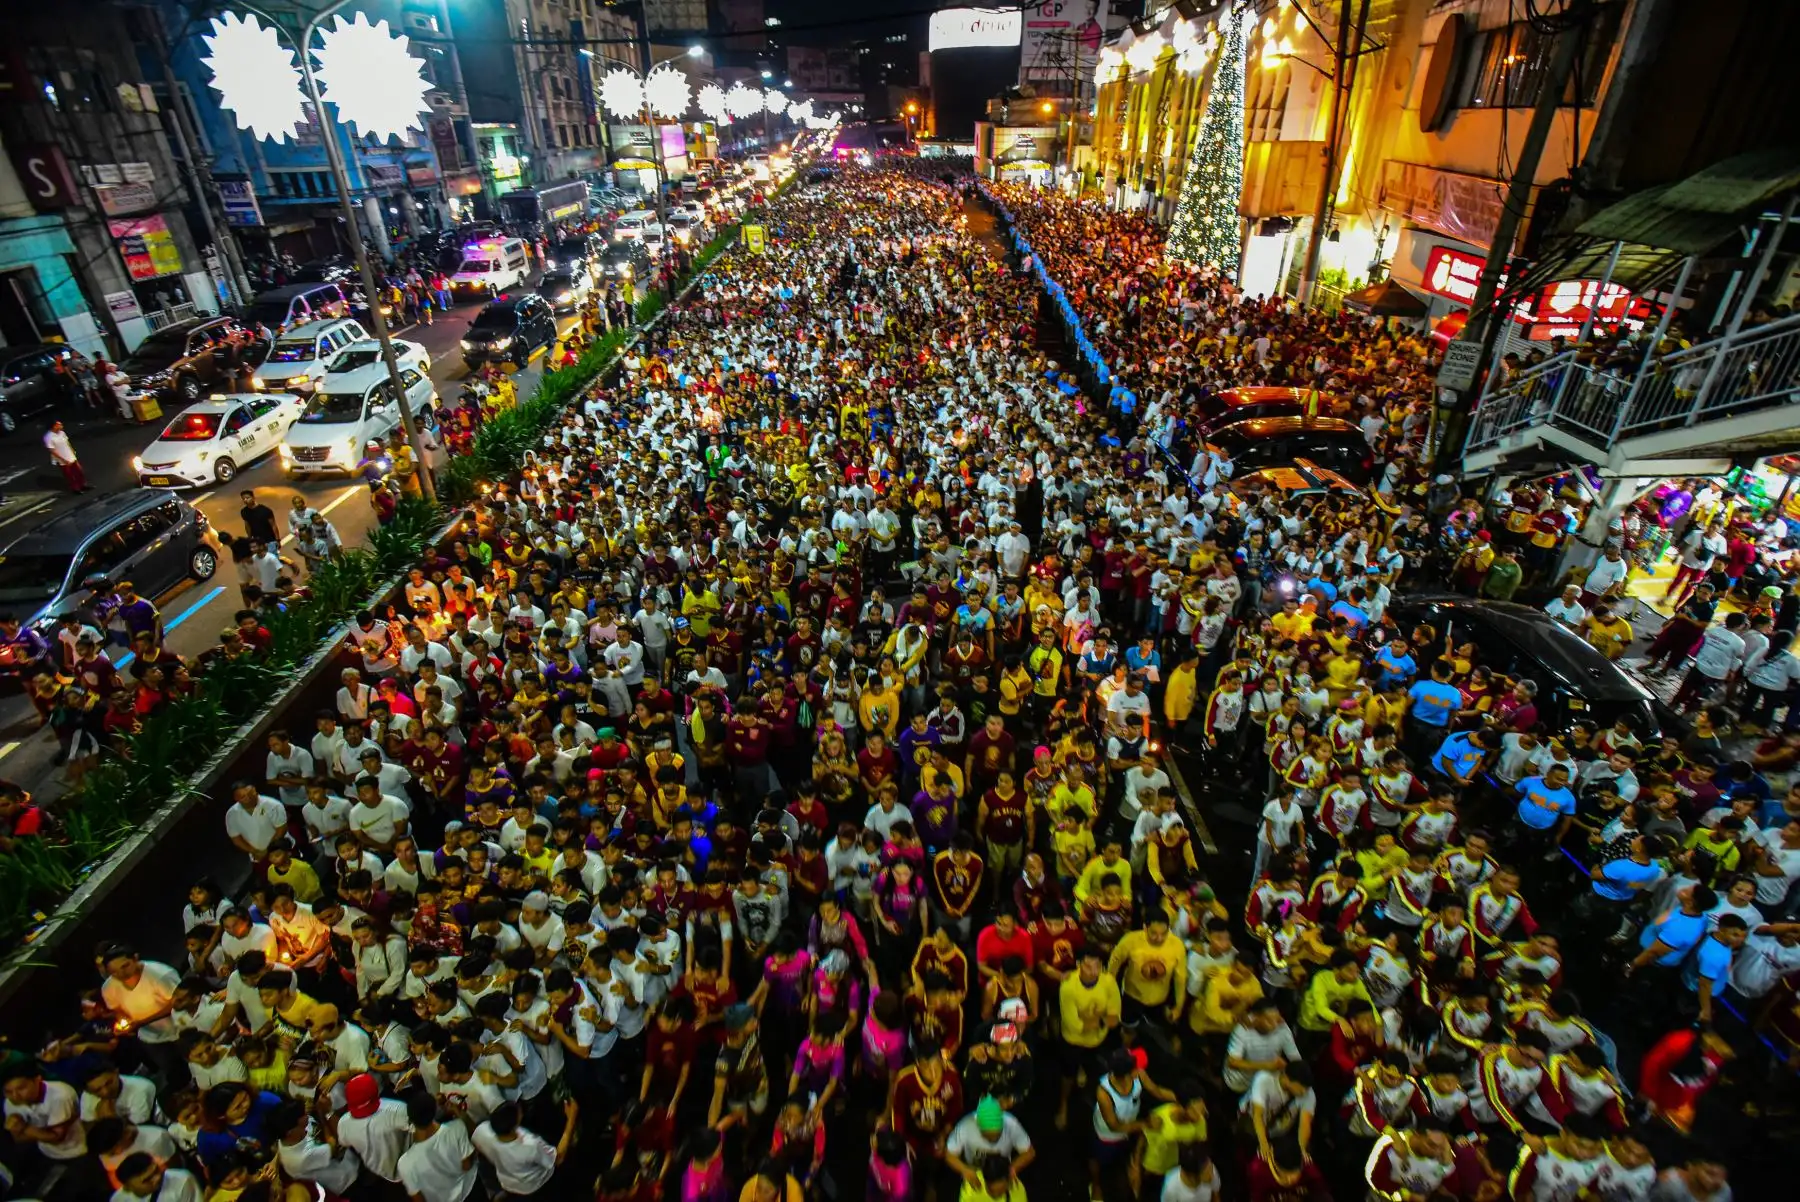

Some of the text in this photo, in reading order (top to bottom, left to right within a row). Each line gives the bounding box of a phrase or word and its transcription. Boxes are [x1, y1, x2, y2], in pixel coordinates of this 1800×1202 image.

[1034, 2, 1063, 18] TGP
[28, 158, 56, 197] S
[1450, 352, 1476, 363] ZONE
